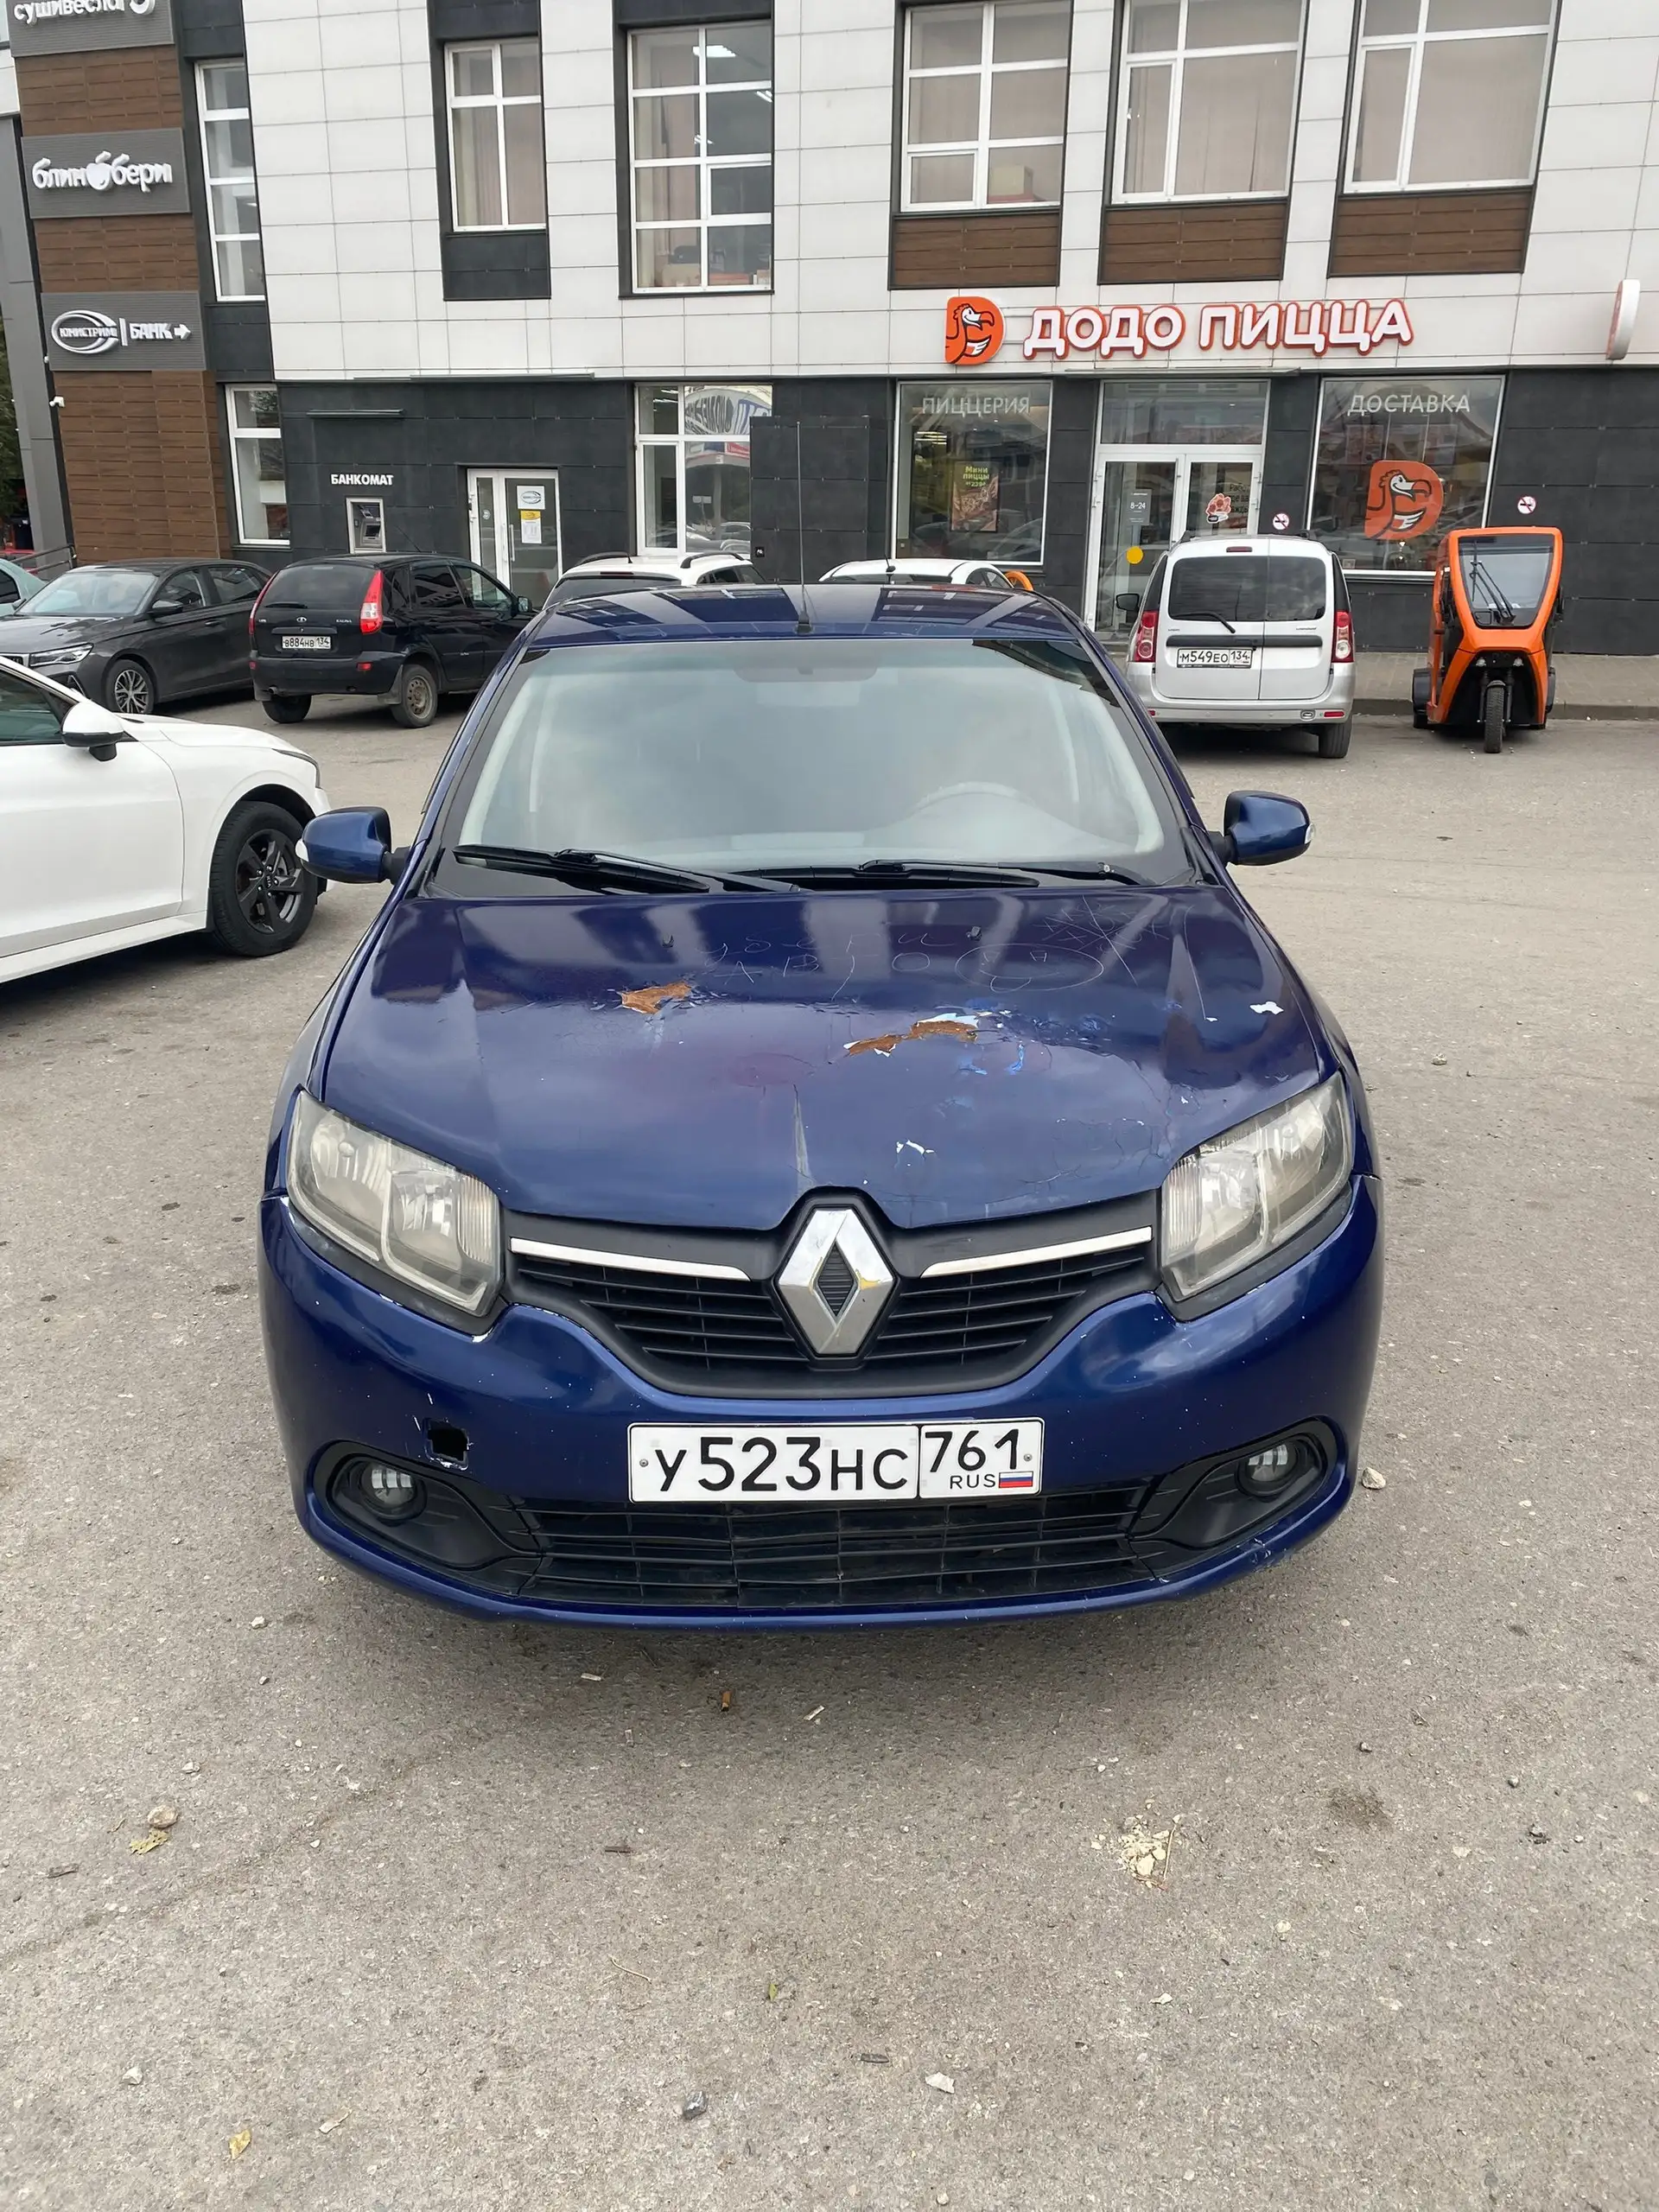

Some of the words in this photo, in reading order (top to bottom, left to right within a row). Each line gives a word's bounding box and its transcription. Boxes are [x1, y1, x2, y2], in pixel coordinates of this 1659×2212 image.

[130, 322, 173, 340] БАНК
[1023, 304, 1185, 359] ДОДО
[1198, 299, 1413, 357] ПИЦЦА
[922, 397, 1030, 418] ПИЦЦЕРИЯ
[1347, 394, 1471, 416] ДОСТАВКА
[330, 474, 394, 486] БАНКОМАТ
[1181, 651, 1229, 663] М549ЕО
[1230, 651, 1248, 660] 134
[655, 1436, 908, 1492] У523НС
[925, 1429, 1020, 1473] 761
[950, 1474, 995, 1490] RUS
